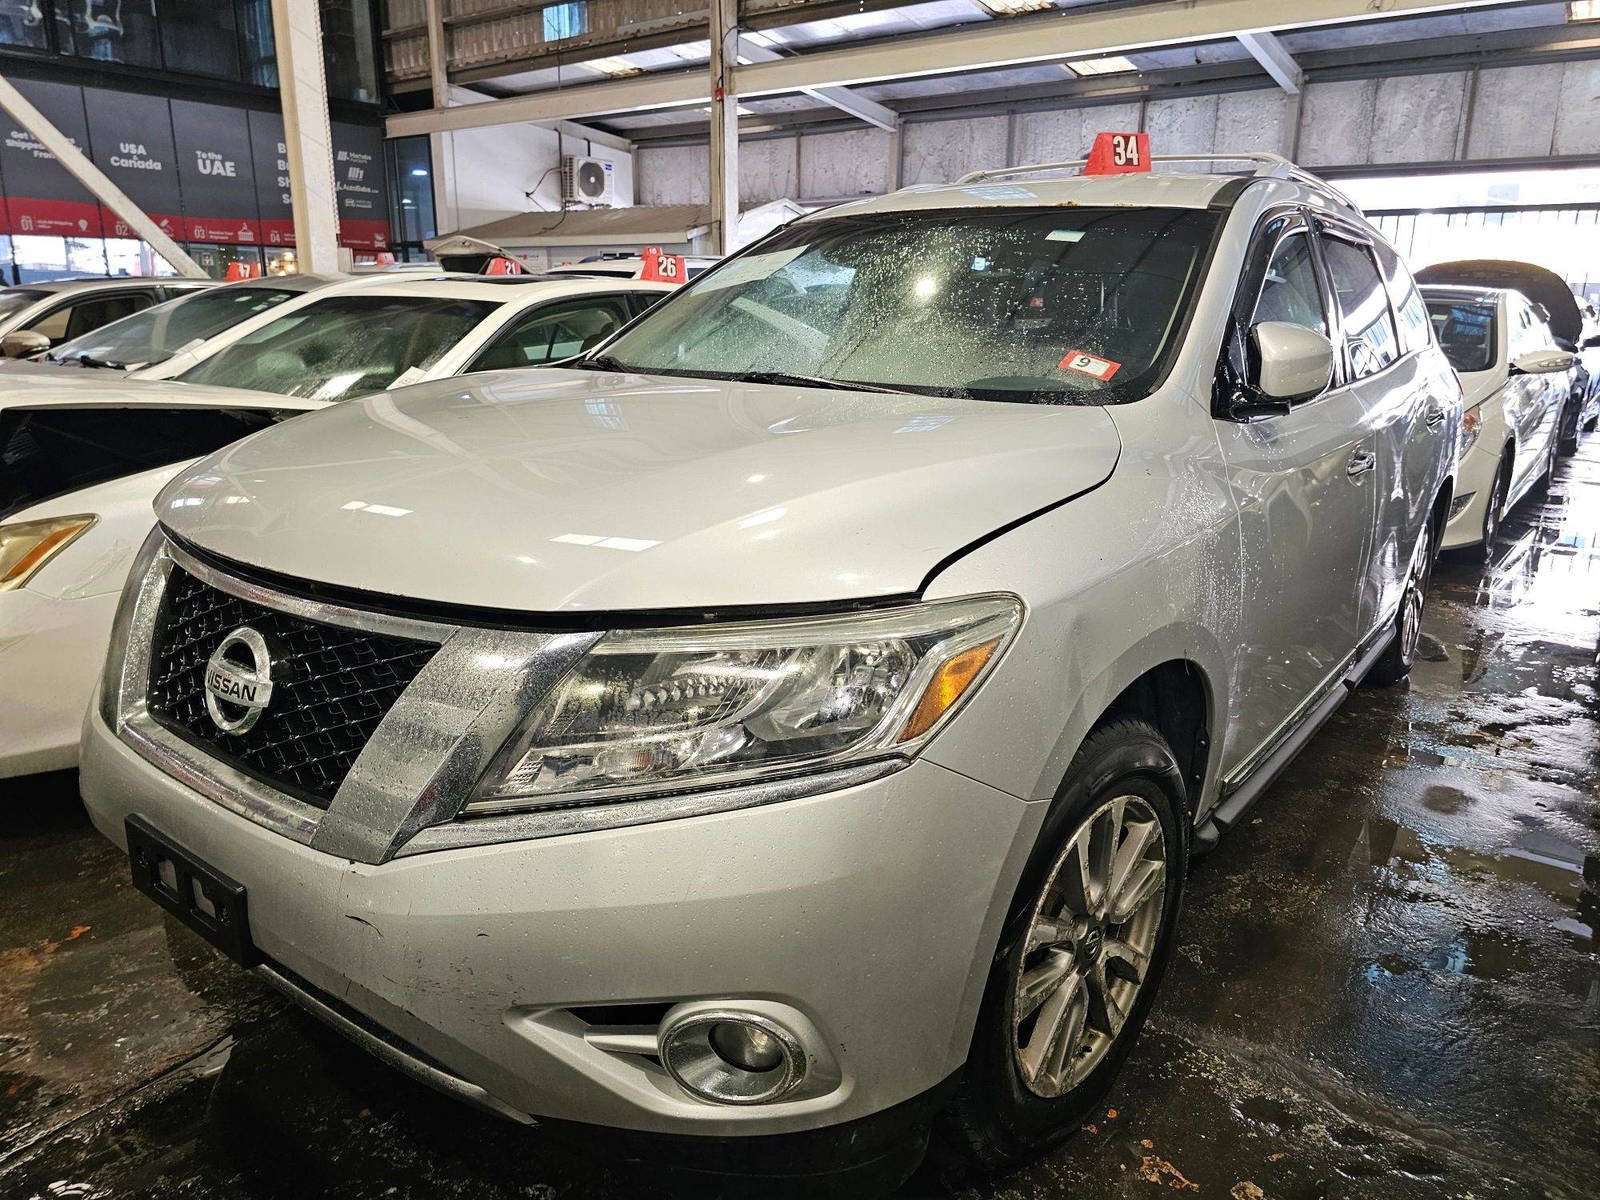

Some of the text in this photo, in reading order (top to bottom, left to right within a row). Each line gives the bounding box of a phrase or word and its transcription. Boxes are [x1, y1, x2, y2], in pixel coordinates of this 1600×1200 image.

[10, 131, 29, 140] Get
[5, 138, 47, 151] Shippe
[119, 142, 147, 155] USA
[1112, 136, 1139, 166] 34
[195, 150, 223, 160] To the
[110, 156, 162, 171] Canada
[197, 159, 236, 177] UAE
[115, 224, 129, 236] 02
[194, 228, 206, 239] 03
[658, 256, 677, 277] 26
[207, 669, 257, 702] NISSAN
